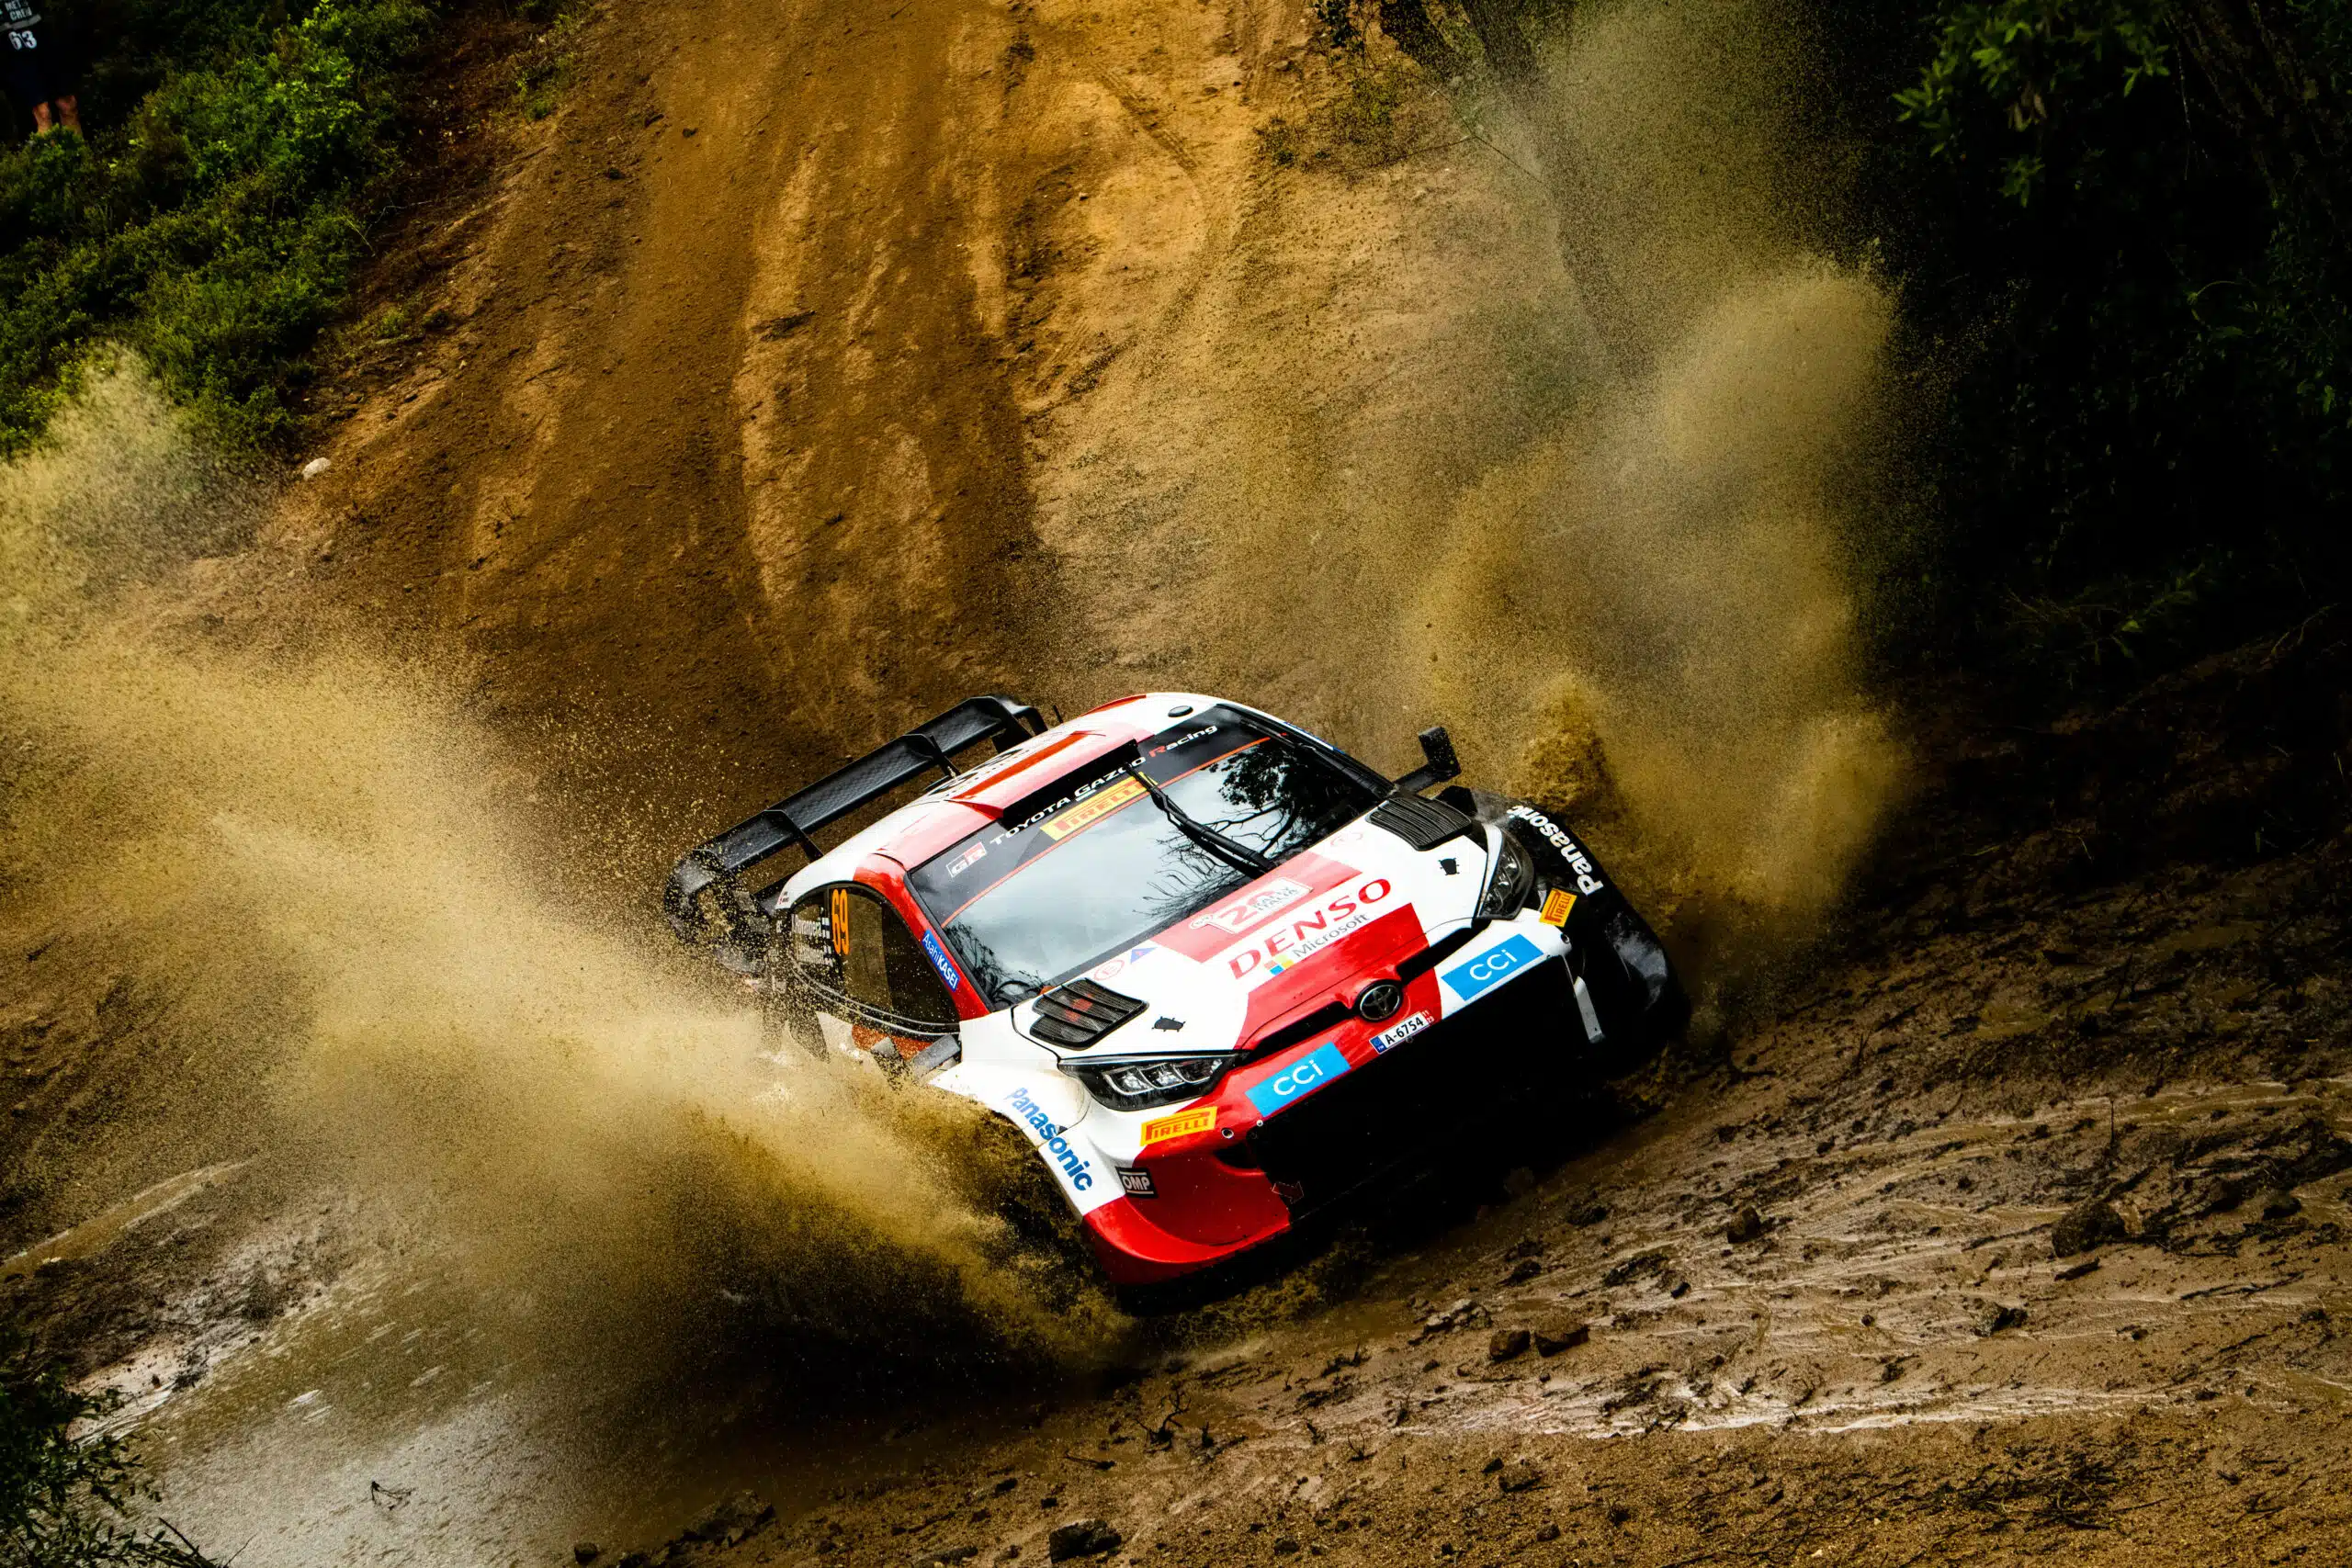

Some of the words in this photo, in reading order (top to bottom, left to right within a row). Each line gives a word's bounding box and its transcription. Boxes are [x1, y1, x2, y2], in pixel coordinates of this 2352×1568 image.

[9, 30, 37, 50] 63
[990, 796, 1071, 845] TOYOTA
[1149, 725, 1217, 758] Racing
[949, 844, 988, 876] GR
[1507, 806, 1604, 896] Panasonic
[831, 889, 850, 954] 69
[1544, 888, 1572, 922] PIRELLI
[1227, 878, 1391, 979] DENSO
[1292, 911, 1370, 960] Microsoft
[1385, 1016, 1424, 1044] A-6754
[1004, 1088, 1092, 1191] Panasonic
[1146, 1111, 1210, 1140] PIRELLI
[1122, 1175, 1151, 1191] OMP
